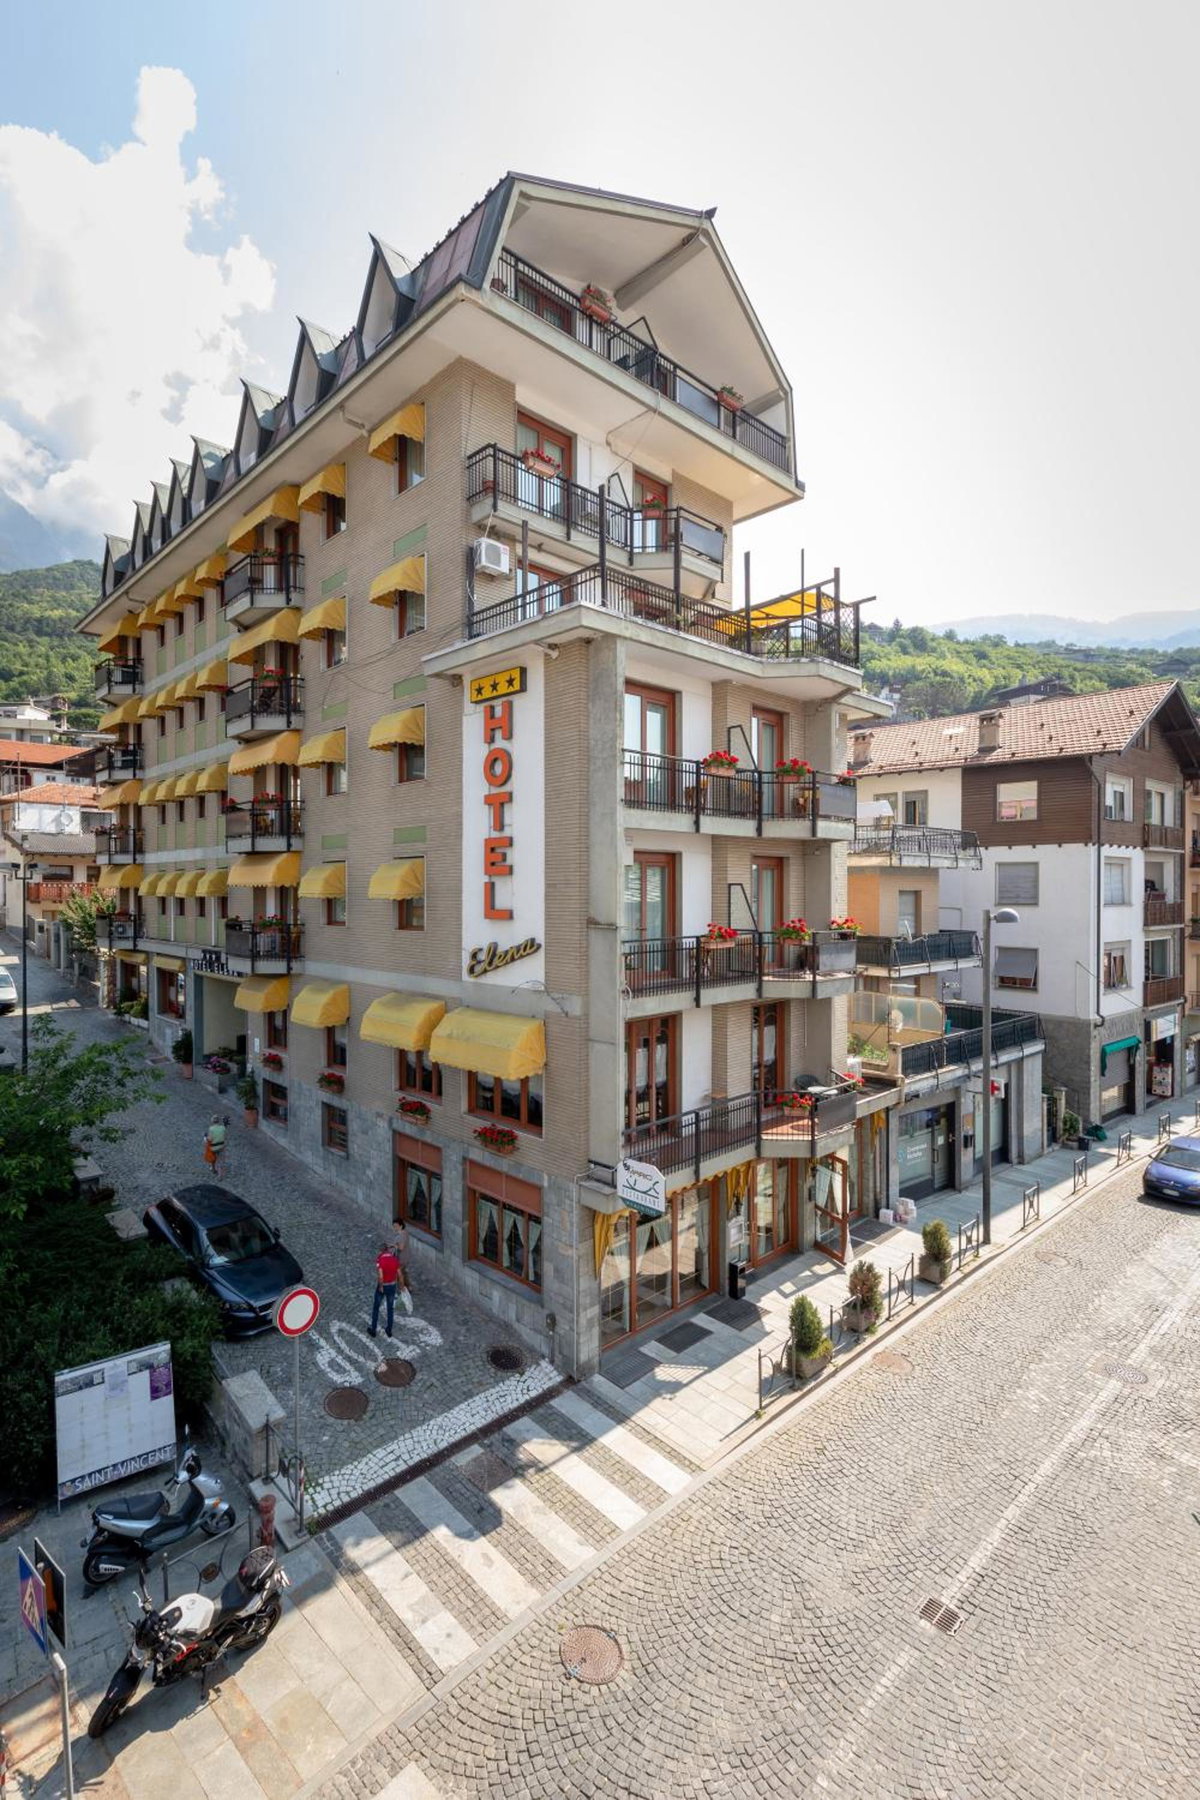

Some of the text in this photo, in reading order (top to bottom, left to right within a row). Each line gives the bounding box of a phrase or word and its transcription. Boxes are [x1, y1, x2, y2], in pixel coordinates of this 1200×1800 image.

[484, 699, 513, 919] HOTEL
[467, 937, 542, 978] Elena
[73, 1445, 173, 1491] SAINT-VINCENT
